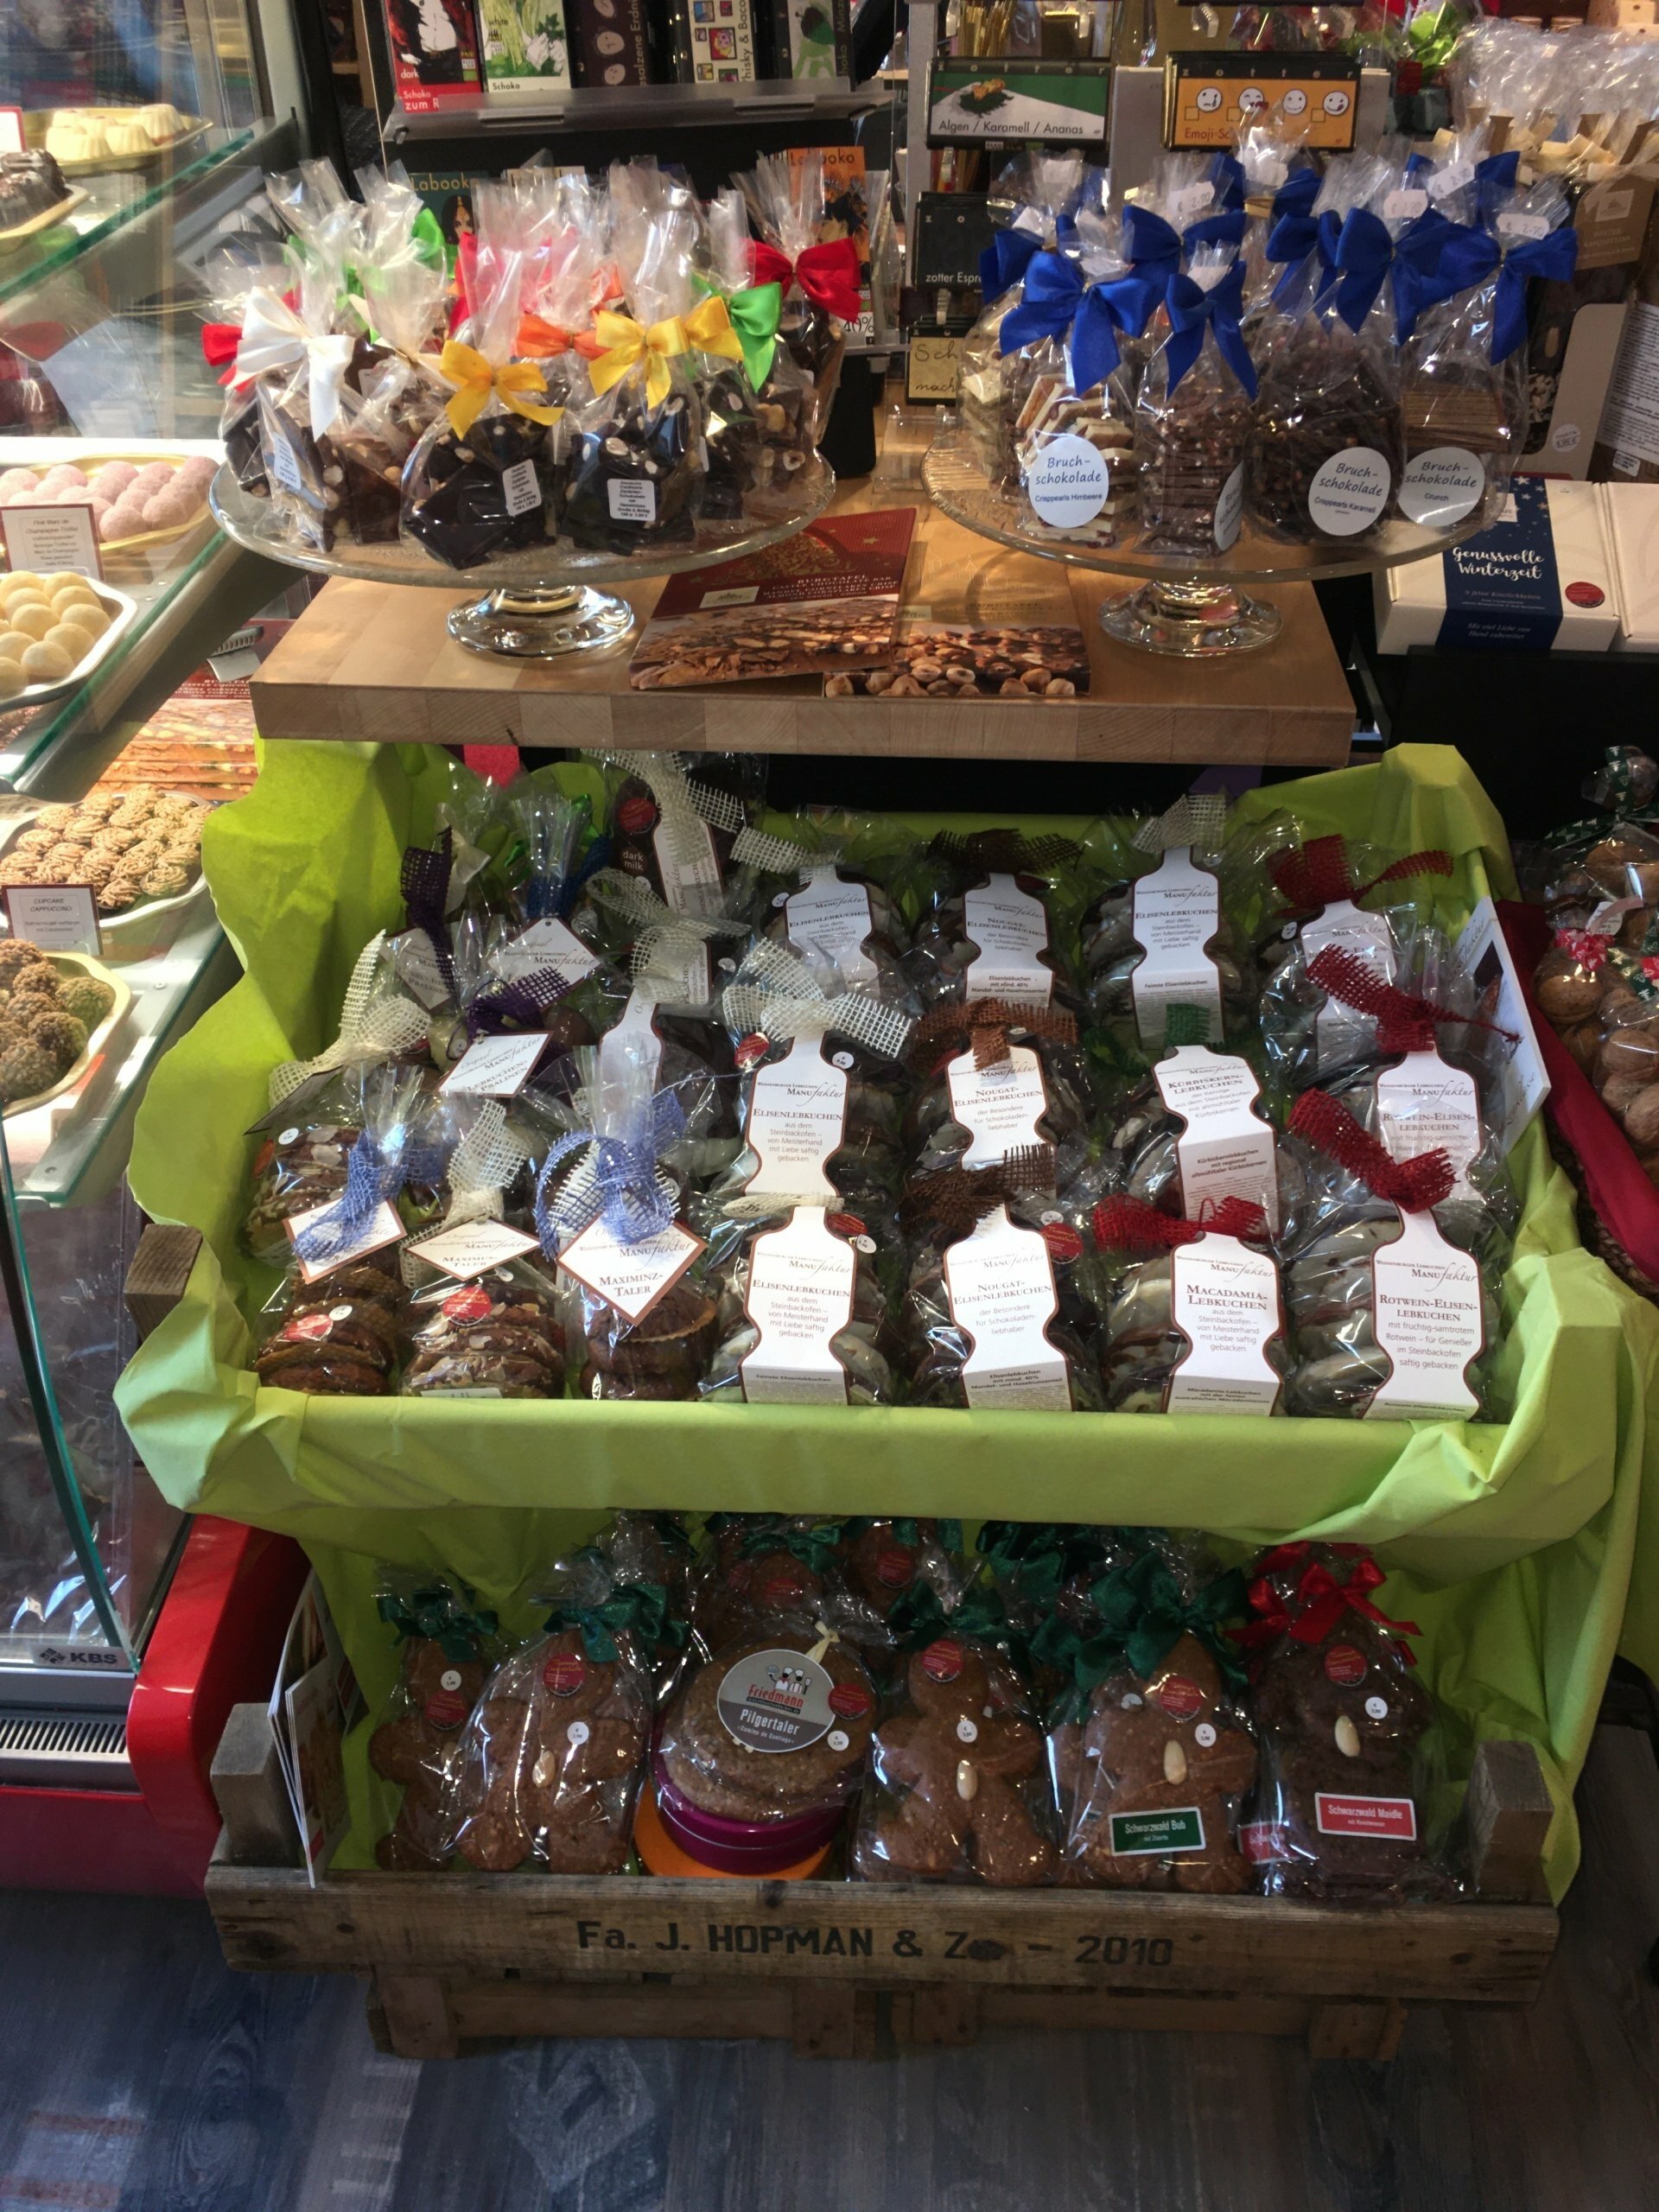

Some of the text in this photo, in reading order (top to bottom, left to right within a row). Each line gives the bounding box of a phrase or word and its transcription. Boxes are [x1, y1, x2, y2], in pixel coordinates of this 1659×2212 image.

[632, 36, 646, 86] esalzene
[742, 48, 753, 82] hisky
[401, 67, 418, 79] dark
[404, 90, 431, 99] Schoko
[405, 102, 428, 111] zum
[939, 120, 1084, 134] Algen / Karamell / Ananas
[1185, 128, 1230, 142] Emoji-Sc
[411, 173, 471, 192] Labook
[925, 274, 954, 283] zotter
[1047, 454, 1091, 468] Bruch-
[1421, 461, 1470, 472] Bruch-
[1336, 462, 1378, 478] Bruch-
[1036, 470, 1102, 485] schokolade
[1404, 474, 1478, 488] schokolade
[1319, 477, 1382, 497] schokolade
[1424, 493, 1449, 501] Crunch
[1452, 546, 1545, 563] Genussvolle
[1458, 562, 1542, 581] Winterzeit
[623, 850, 644, 861] dark
[624, 860, 644, 871] milk
[1135, 909, 1217, 919] ELISENLEBKUCHEN
[467, 1060, 527, 1091] LEBKUCHEN-
[480, 1067, 528, 1092] PRALINEN
[981, 1061, 1037, 1085] MANUfaktur
[786, 1082, 844, 1107] MANUfaktur
[976, 1086, 1020, 1097] NOUGAT-
[1173, 1080, 1243, 1095] LEBKUCHEN
[1412, 1080, 1473, 1107] MANUfaktur
[954, 1090, 1043, 1107] ELISENLEBKUCHEN
[753, 1109, 842, 1121] ELISENLEBKUCHEN
[990, 1105, 1023, 1114] Besondere
[985, 1112, 1029, 1122] Schokoladen-
[769, 1128, 816, 1137] Steinbackofen
[781, 1138, 823, 1147] Meisterhand
[801, 1147, 819, 1155] saftig
[1223, 1157, 1247, 1166] regional
[620, 1232, 693, 1271] MANUfaktur
[789, 1255, 851, 1281] MANUfaktur
[1211, 1262, 1274, 1282] MANUfaktur
[599, 1272, 664, 1287] MAXIMINZ-
[1411, 1262, 1478, 1292] MANUfaktur
[613, 1285, 652, 1296] TALER
[753, 1279, 850, 1297] ELISENLEBKUCHEN
[977, 1280, 1025, 1293] NOUGAT-
[1186, 1284, 1268, 1300] MACADAMIA-
[954, 1285, 1052, 1305] ELISENLEBKUCHEN
[771, 1302, 822, 1313] Steinbackofen
[994, 1304, 1031, 1314] Besondere
[1188, 1295, 1267, 1310] LEBKUCHEN
[1380, 1294, 1478, 1311] ROTWEIN-ELISEN-
[784, 1313, 829, 1323] Meisterhand
[988, 1313, 1036, 1325] Schokoladen-
[1198, 1315, 1251, 1325] Steinbackofen
[1396, 1309, 1461, 1321] LEBKUCHEN
[779, 1330, 814, 1339] gebacken
[804, 1323, 825, 1332] saftig
[991, 1325, 1025, 1335] liebhaber
[1212, 1325, 1260, 1335] Meisterhand
[1402, 1322, 1475, 1335] fruchtig-samtrotem
[1236, 1335, 1256, 1345] saftig
[1386, 1332, 1416, 1342] Rotwein
[1438, 1337, 1472, 1347] Genießer
[1408, 1346, 1462, 1358] Steinbackofen
[1399, 1358, 1459, 1370] saftig gebacken
[70, 1652, 118, 1664] KBS
[748, 1684, 804, 1708] Friedmann
[740, 1708, 800, 1735] Pilgertaler
[1327, 1805, 1403, 1819] Schwarzwald Maidle
[1124, 1820, 1186, 1834] Schwarzwald Bub
[576, 1921, 636, 1950] Fa.
[655, 1923, 690, 1951] J.
[708, 1923, 873, 1957] HOPMAN
[893, 1930, 923, 1958] &
[1075, 1936, 1173, 1966] 2010
